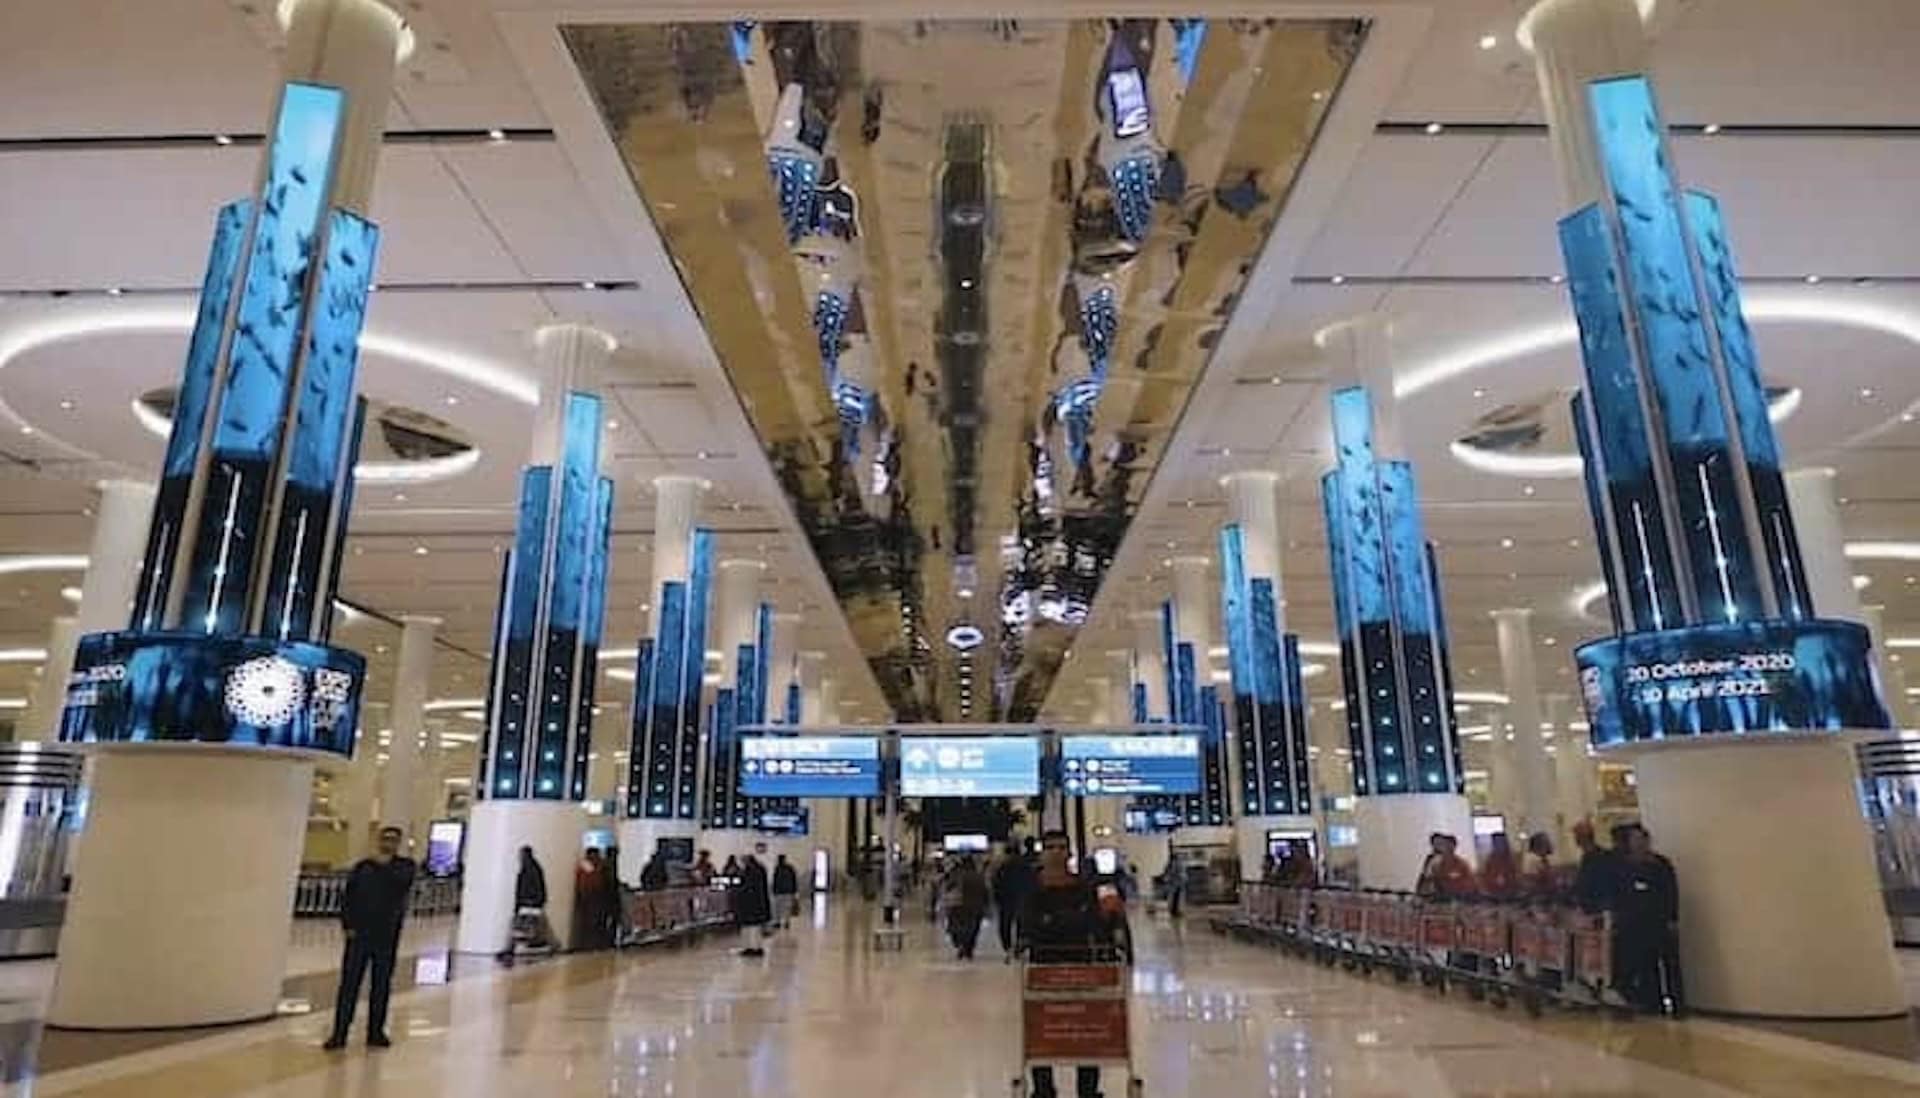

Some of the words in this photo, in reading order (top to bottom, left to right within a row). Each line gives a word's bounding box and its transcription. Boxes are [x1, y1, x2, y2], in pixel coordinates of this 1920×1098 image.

[1651, 661, 1734, 680] October
[1739, 653, 1796, 671] 2020
[1667, 681, 1714, 701] April
[1718, 680, 1768, 696] 2021
